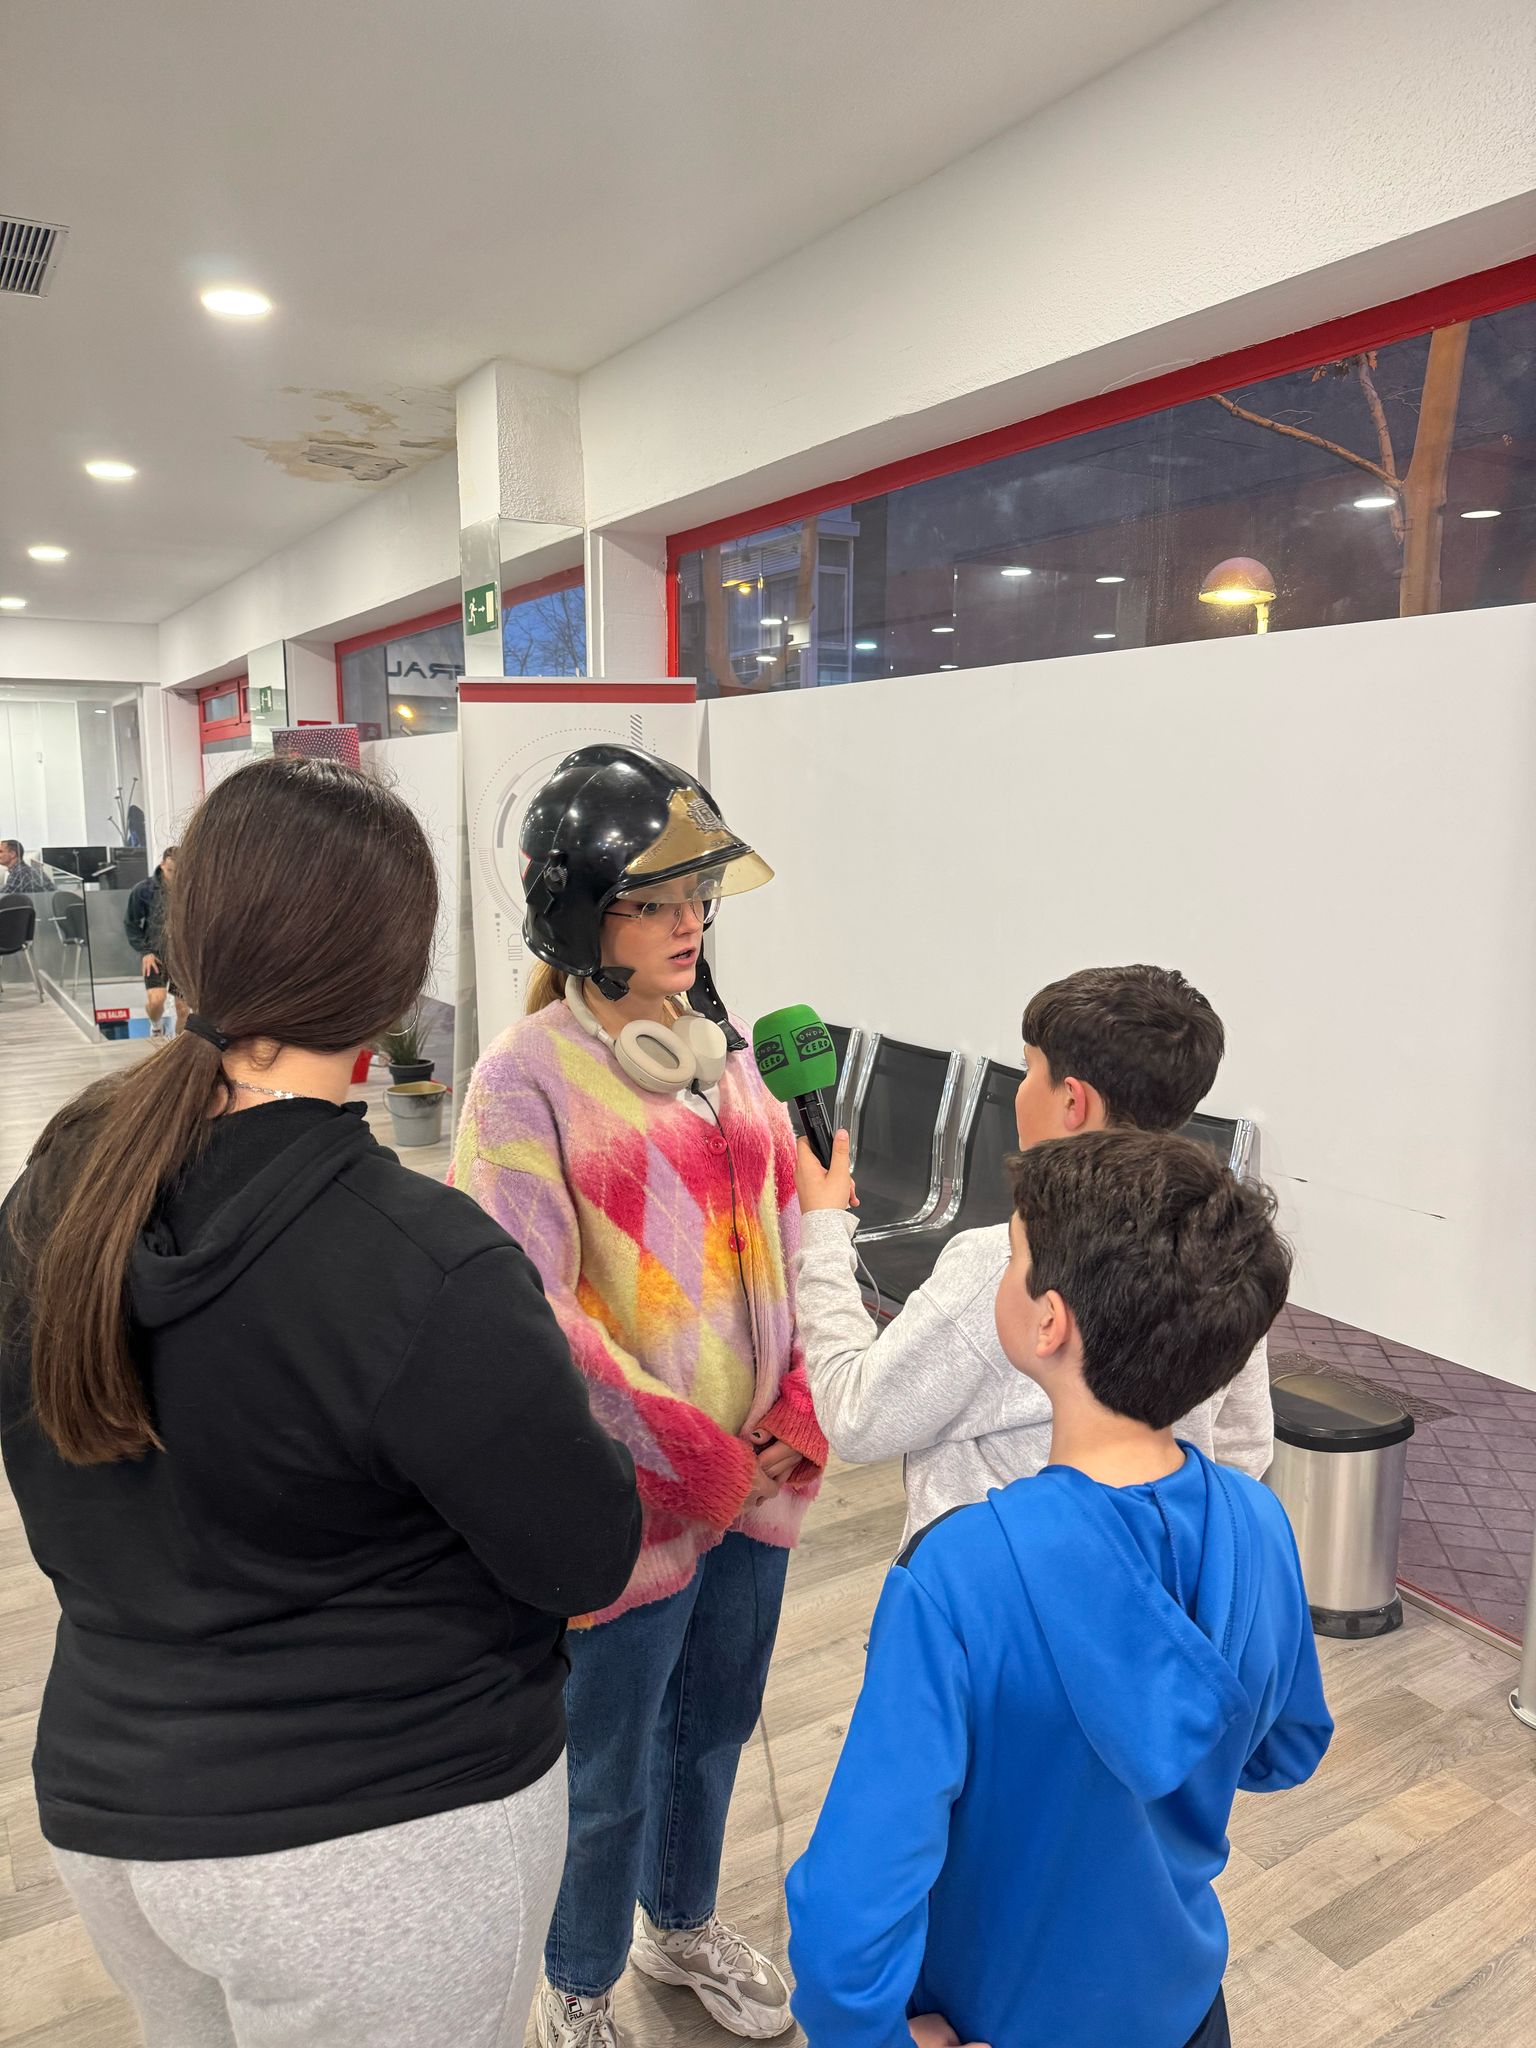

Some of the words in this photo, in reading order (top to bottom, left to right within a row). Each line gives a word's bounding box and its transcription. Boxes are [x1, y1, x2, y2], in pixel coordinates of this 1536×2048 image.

[107, 1010, 127, 1019] SALIDA
[799, 1029, 824, 1041] ONDA
[805, 1039, 829, 1054] CERO
[760, 1055, 782, 1070] CERO
[569, 2011, 585, 2022] FILA
